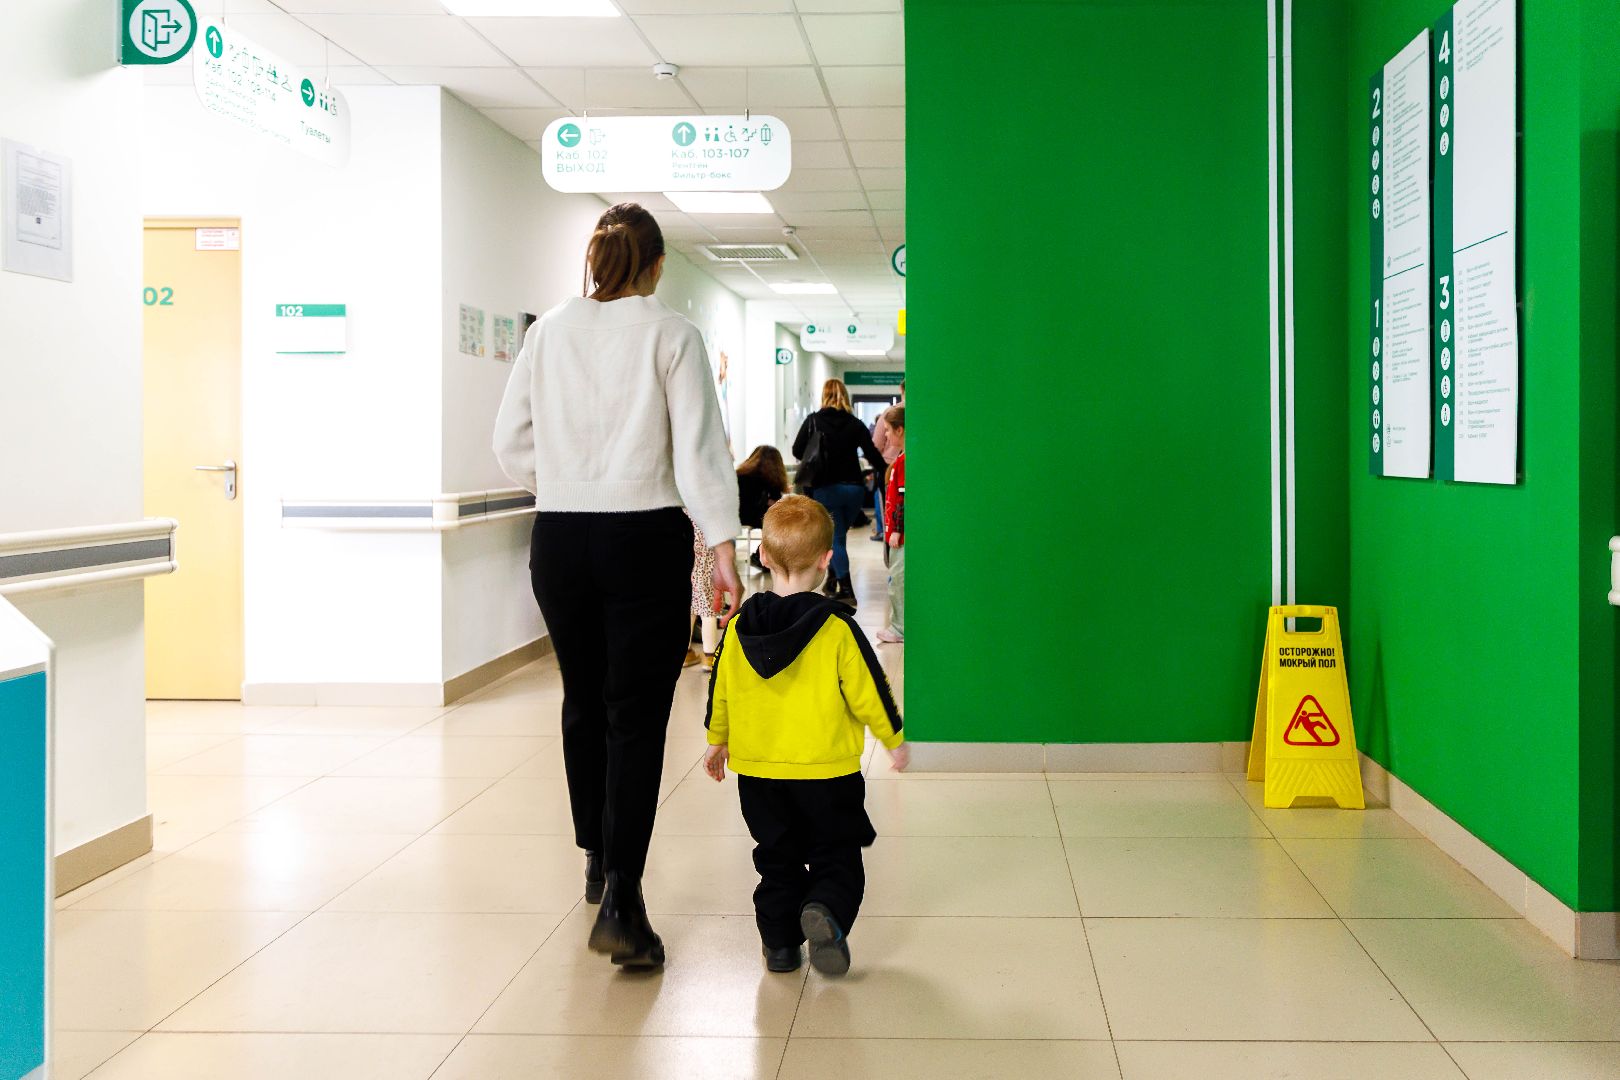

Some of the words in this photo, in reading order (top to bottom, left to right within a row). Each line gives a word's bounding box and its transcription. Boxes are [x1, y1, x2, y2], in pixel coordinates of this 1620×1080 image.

[1438, 30, 1451, 65] 4
[1371, 87, 1381, 120] 2
[587, 150, 608, 160] 102
[702, 148, 750, 159] 103-107
[556, 162, 605, 173] ВЫХОД
[1439, 274, 1450, 310] 3
[280, 305, 303, 317] 102
[1374, 298, 1380, 328] 1
[1279, 647, 1335, 657] ОСТОРОЖНО!
[1279, 657, 1316, 668] МОКРЫЙ
[1318, 658, 1336, 668] ПОЛ
